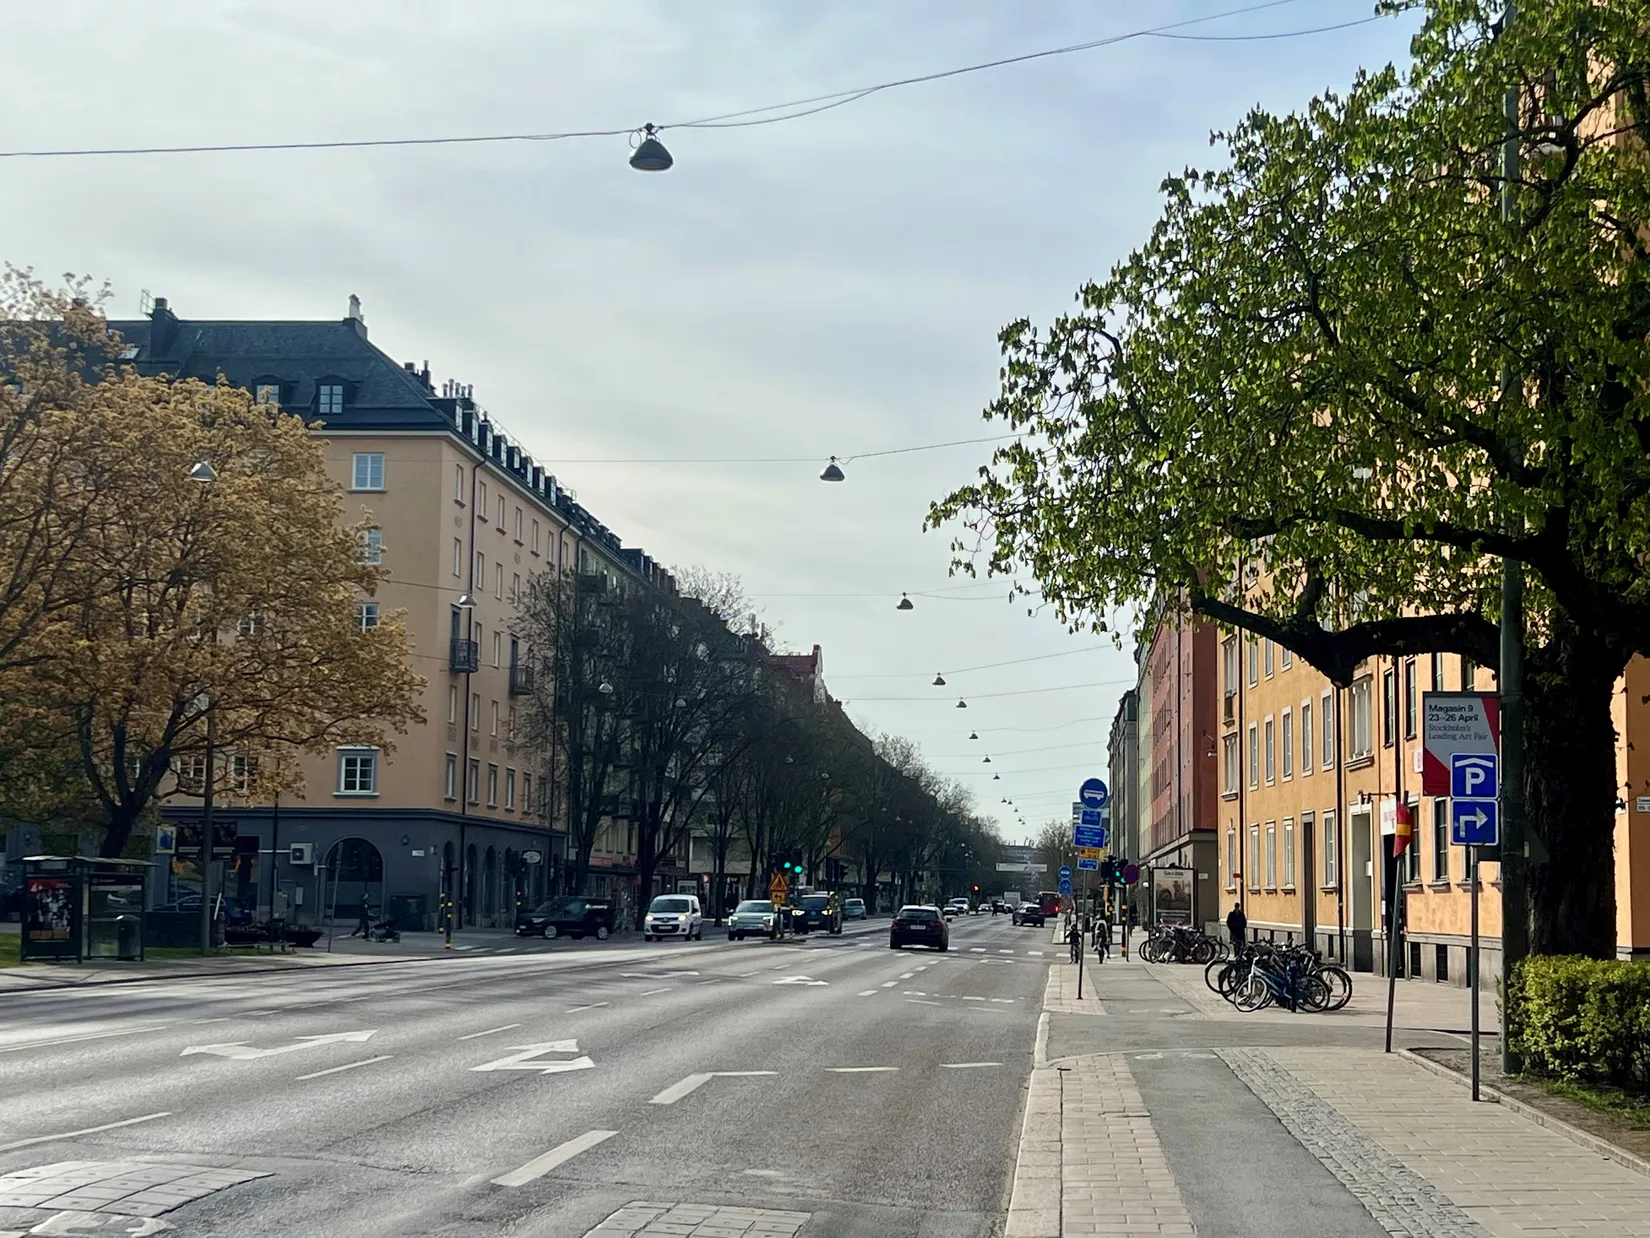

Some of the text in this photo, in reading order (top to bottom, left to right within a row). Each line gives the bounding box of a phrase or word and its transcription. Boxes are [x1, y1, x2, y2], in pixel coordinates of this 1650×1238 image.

[1429, 704, 1473, 714] Magasin 9
[1458, 714, 1478, 723] April
[1428, 732, 1457, 741] Leading
[1474, 732, 1488, 740] Fair
[1466, 767, 1485, 794] P
